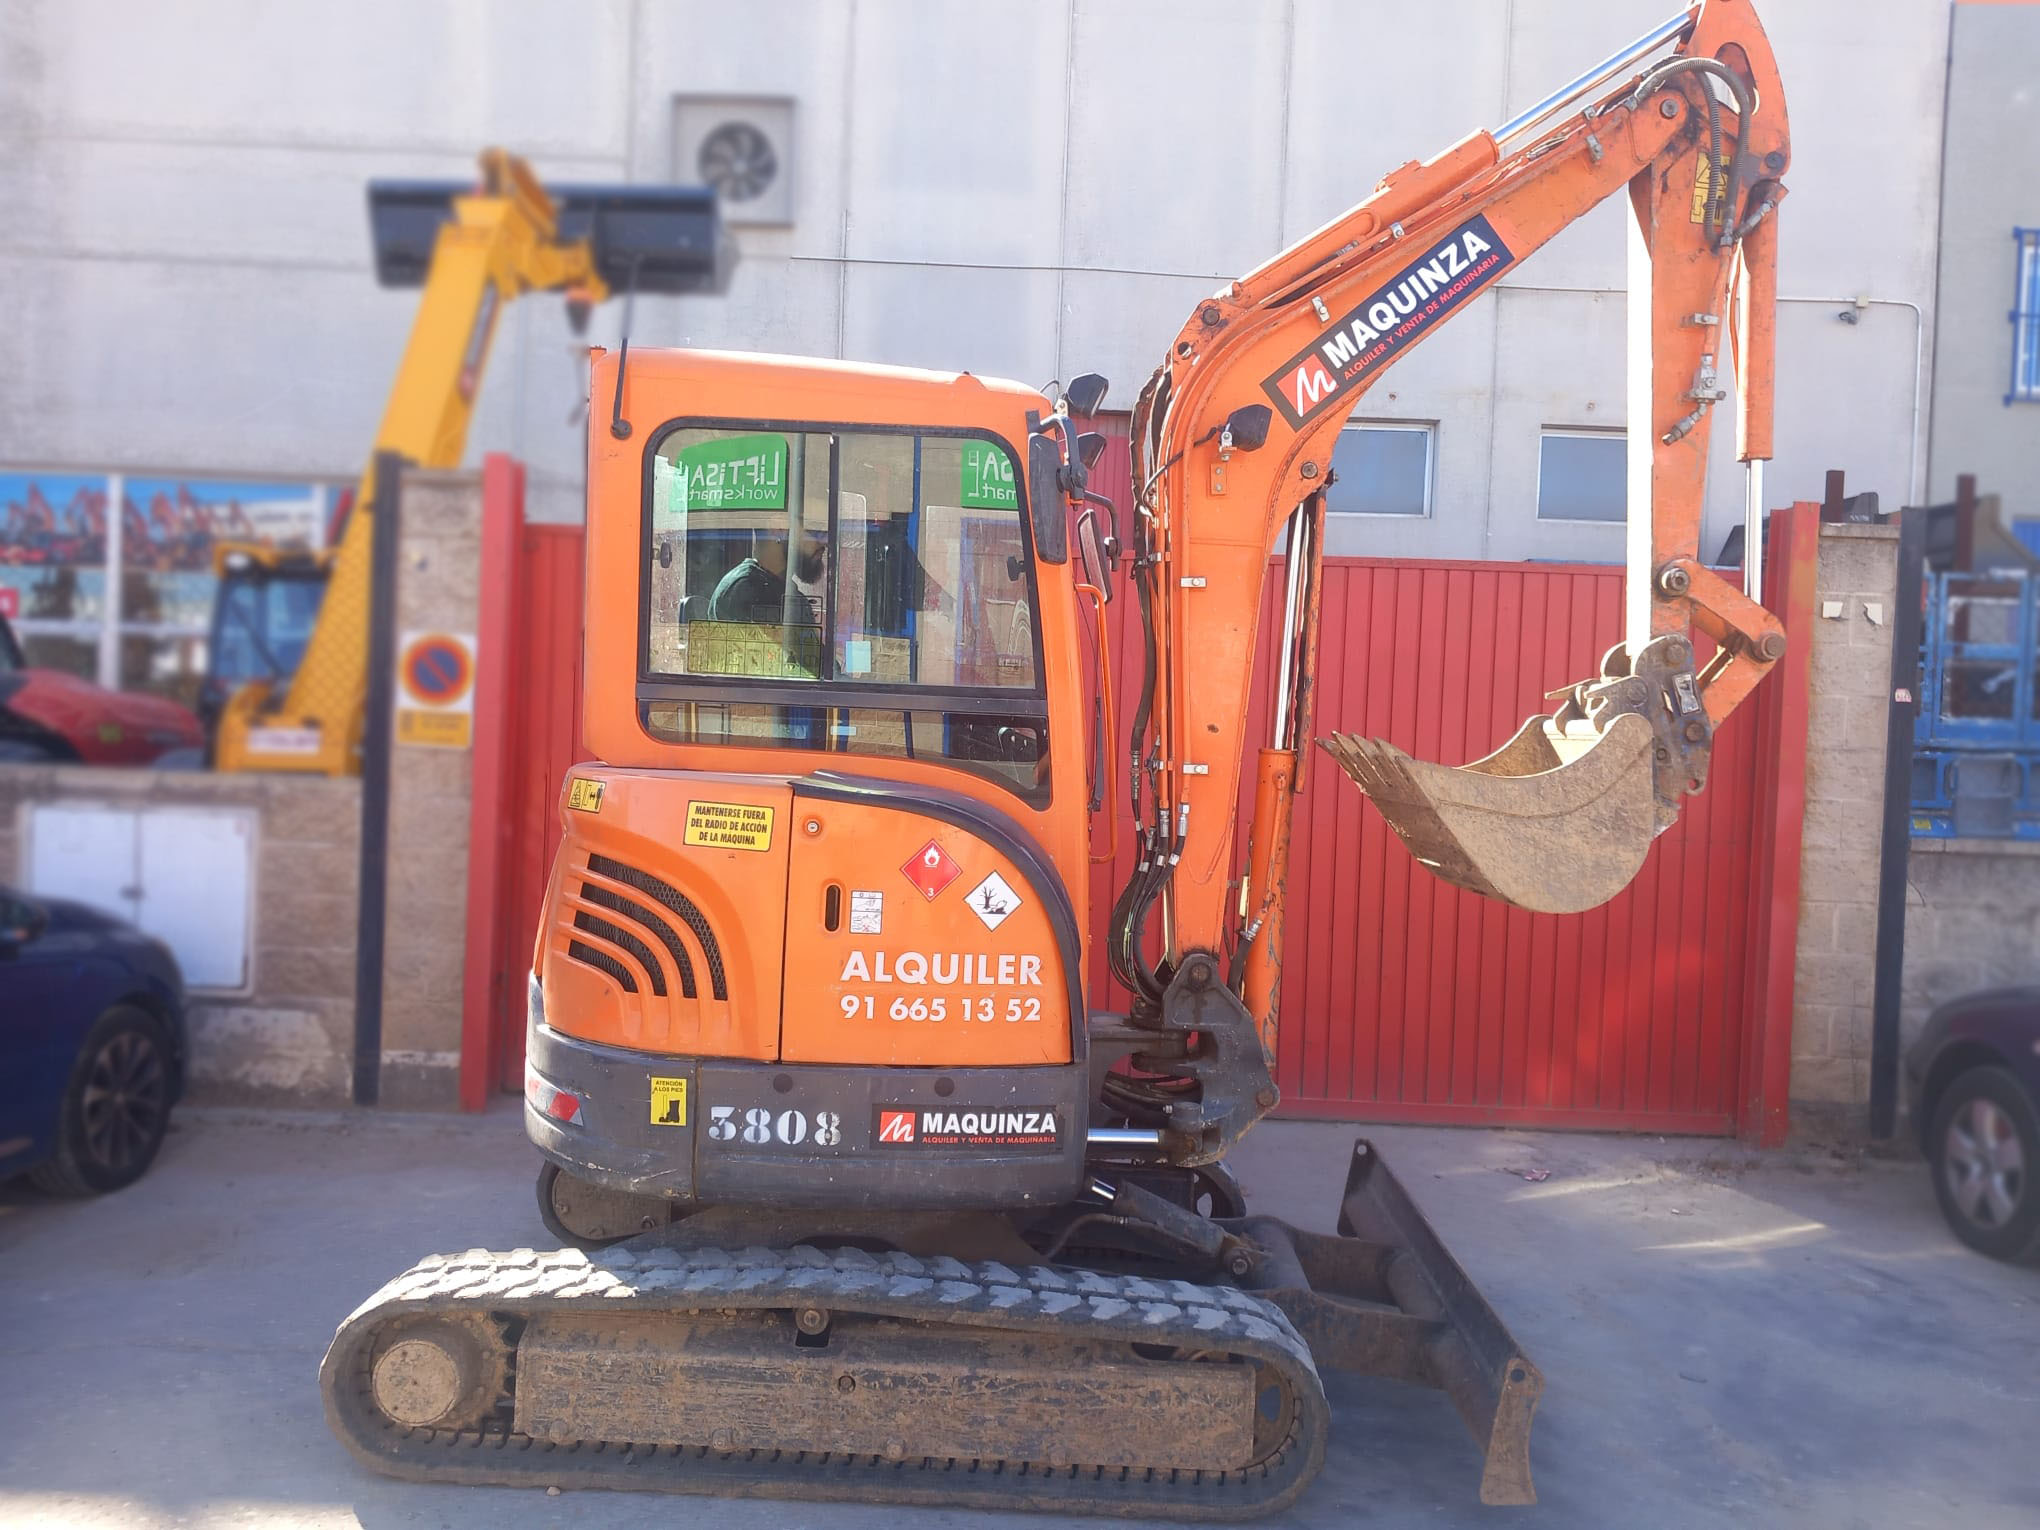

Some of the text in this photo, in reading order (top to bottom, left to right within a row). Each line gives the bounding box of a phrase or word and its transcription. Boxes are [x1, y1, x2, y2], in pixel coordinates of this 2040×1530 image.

[1321, 230, 1491, 369] MAQUINZA
[1344, 253, 1500, 380] ALQUILER Y VENTA DE MAQUINARIA
[694, 805, 766, 821] MANTENERSE FUERA
[690, 818, 768, 834] DEL RADIO DE ACCIÓN
[698, 831, 709, 841] DE
[709, 833, 719, 842] LA
[927, 887, 935, 897] 3
[840, 950, 1043, 985] ALQUILER
[840, 995, 1041, 1022] 91 665 13 52
[708, 1106, 842, 1146] 3808
[922, 1112, 1057, 1135] MAQUINZA
[922, 1136, 958, 1144] ALQUILER
[969, 1136, 993, 1144] VENTA
[995, 1136, 1005, 1144] DE
[1007, 1135, 1056, 1144] MAQUINARIA
